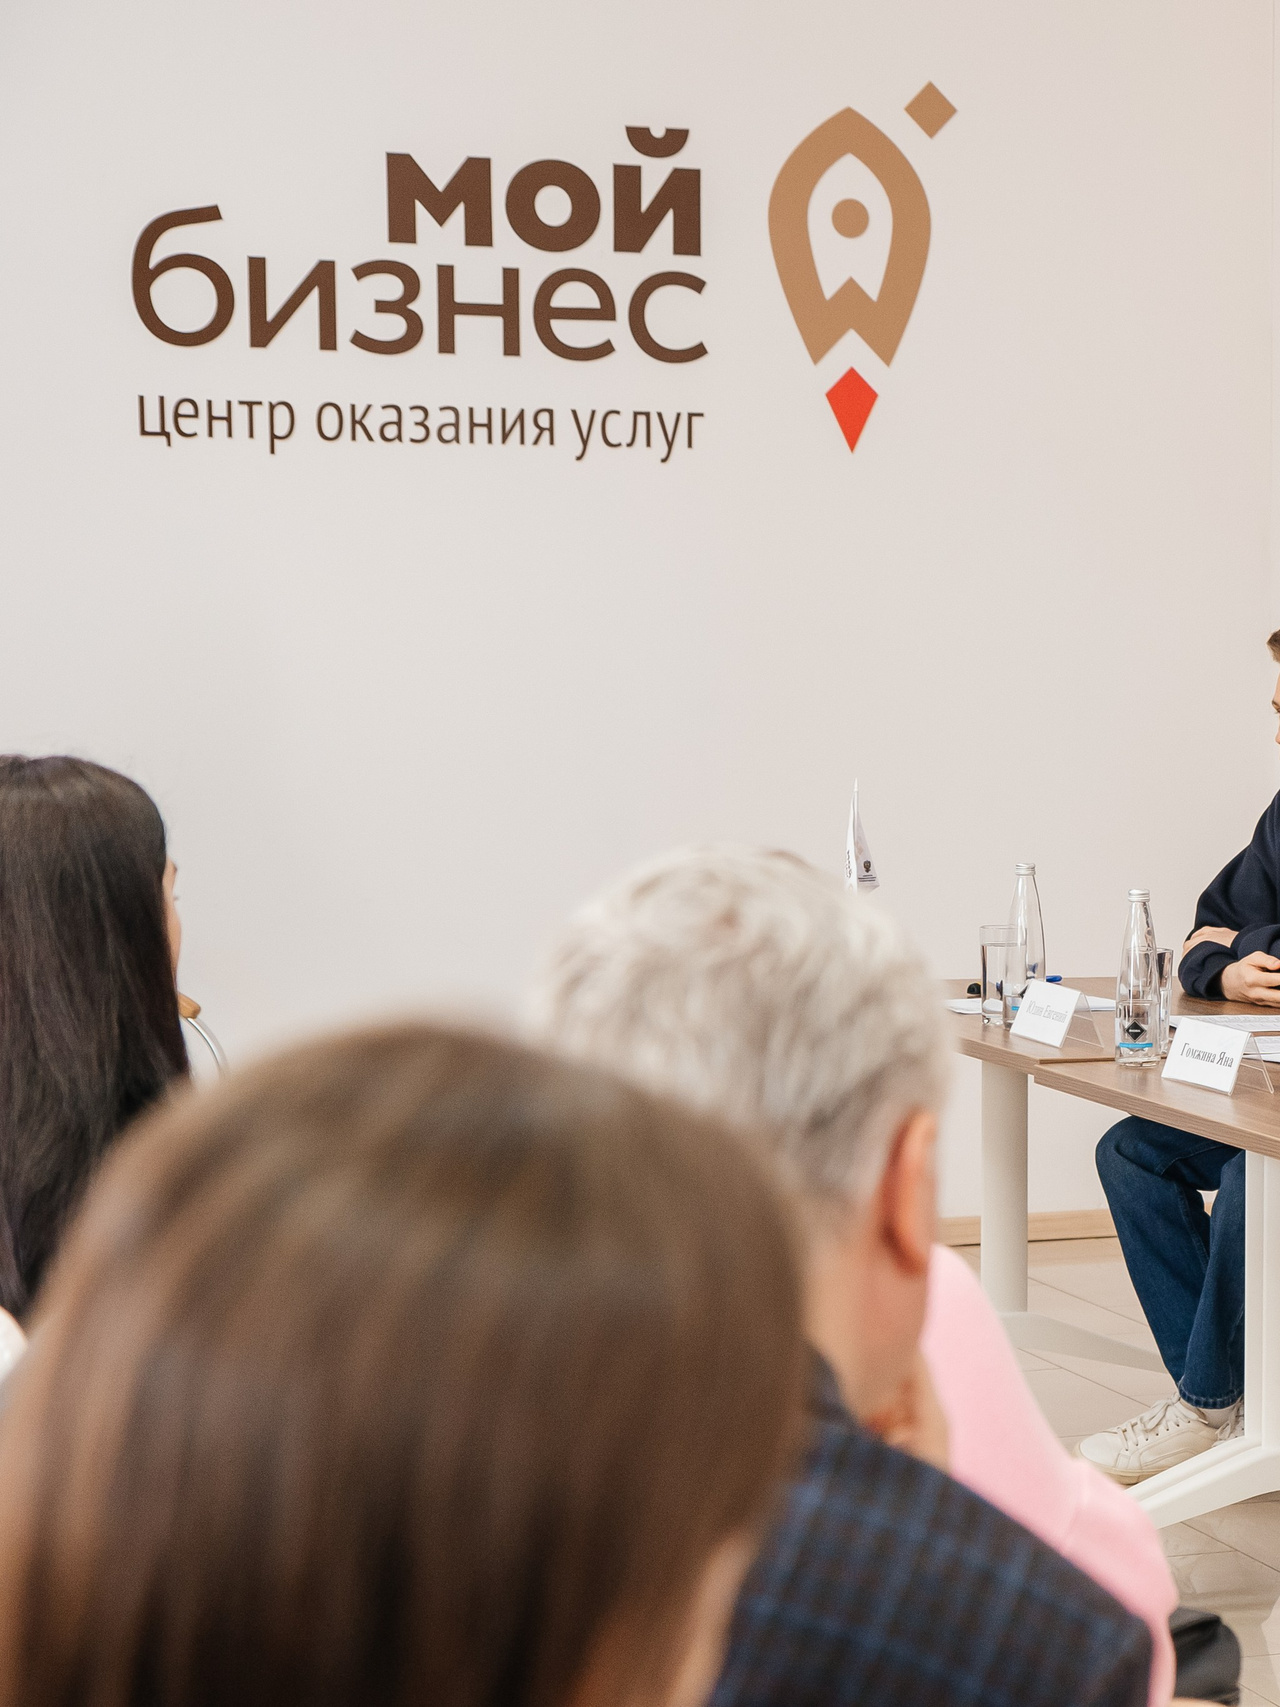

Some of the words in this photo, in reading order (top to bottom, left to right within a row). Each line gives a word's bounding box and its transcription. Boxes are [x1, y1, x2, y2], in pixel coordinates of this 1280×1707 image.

[386, 126, 702, 256] мой
[131, 204, 709, 364] бизнес
[137, 395, 296, 454] центр
[315, 403, 557, 447] оказания
[570, 408, 705, 463] услуг
[1180, 1042, 1216, 1063] Гомжина
[1216, 1051, 1234, 1068] Яна
